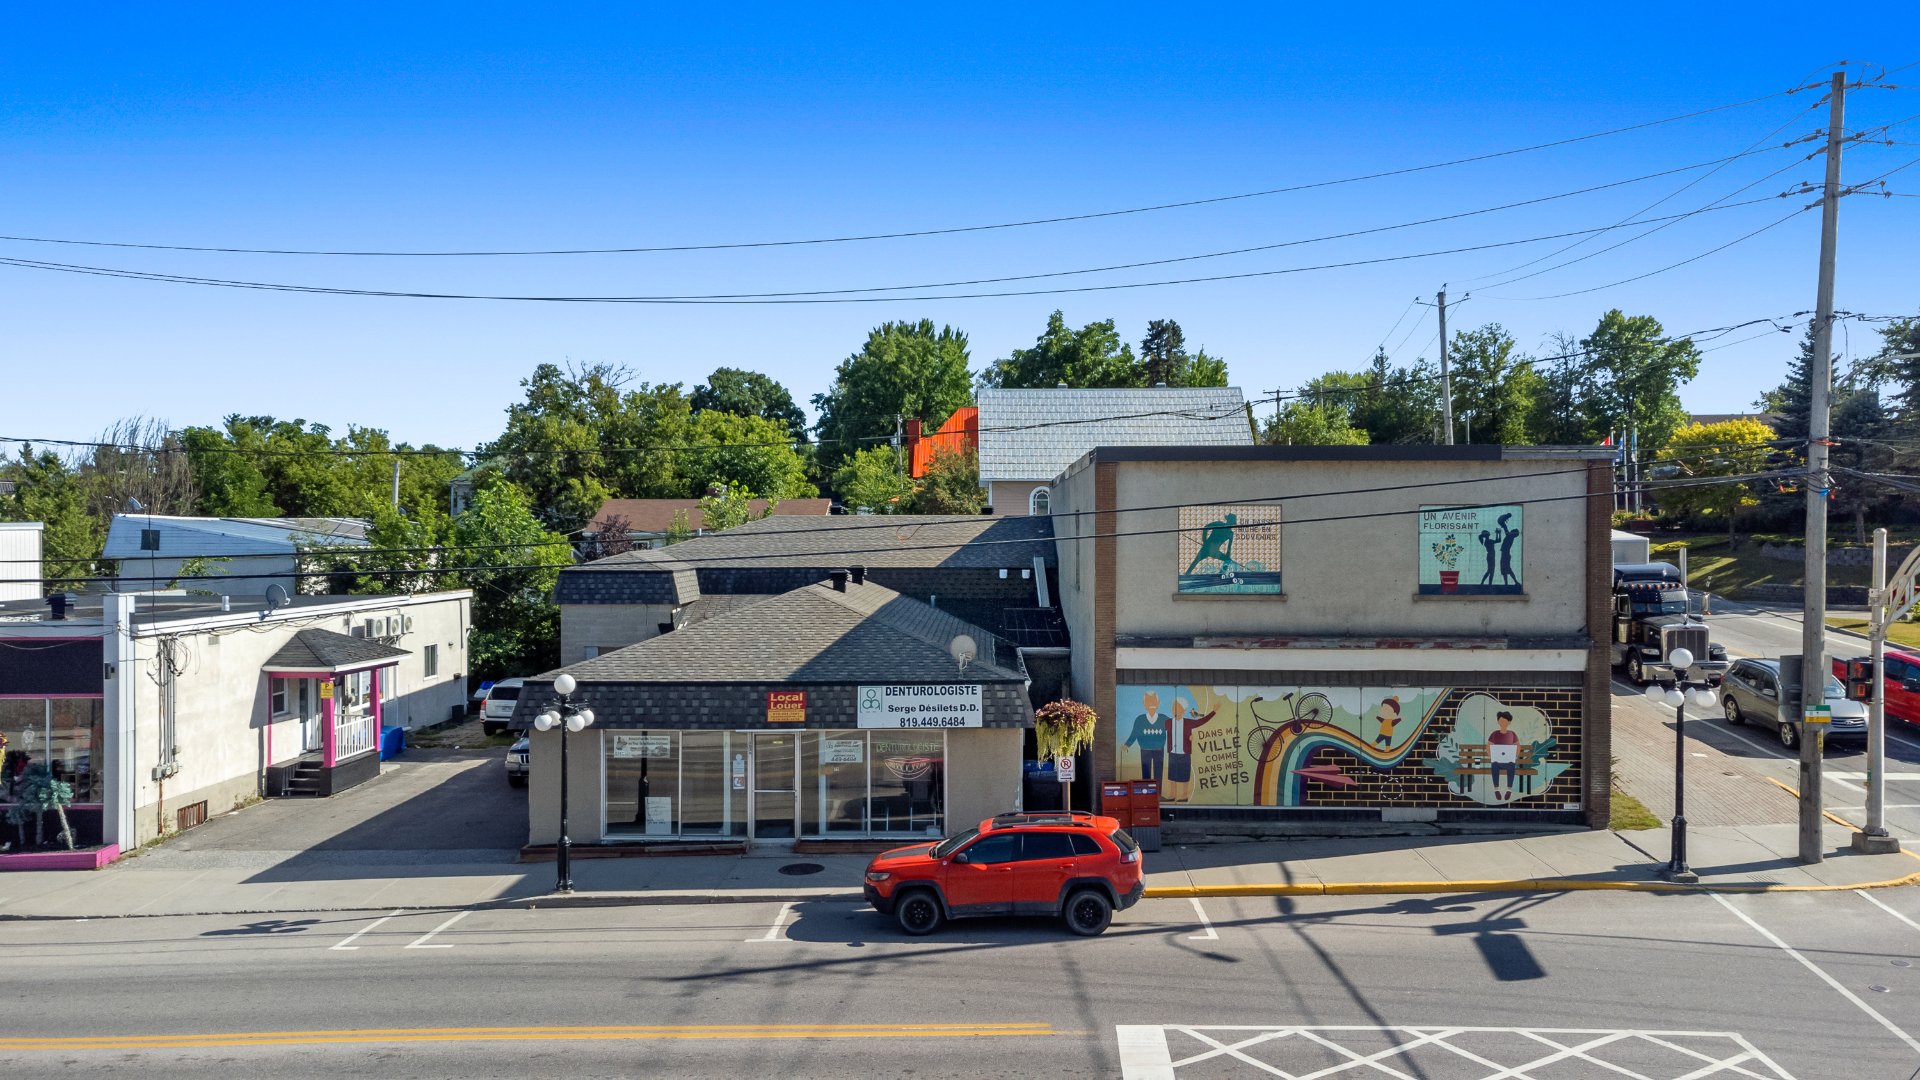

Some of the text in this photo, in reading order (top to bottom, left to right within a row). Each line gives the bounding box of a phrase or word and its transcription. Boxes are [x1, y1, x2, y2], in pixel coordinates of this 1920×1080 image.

[1423, 512, 1477, 521] UN AVENIR
[1423, 522, 1480, 530] FLORISSANT
[770, 692, 803, 701] Local
[885, 686, 978, 696] DENTUROLOGISTE
[888, 703, 980, 714] Serge Désilets D.D.
[899, 716, 966, 728] 819.449.6484
[1198, 727, 1239, 740] DANS MA
[1198, 736, 1241, 753] VILLE
[1205, 752, 1238, 763] COMME
[1198, 761, 1244, 775] DANS MES
